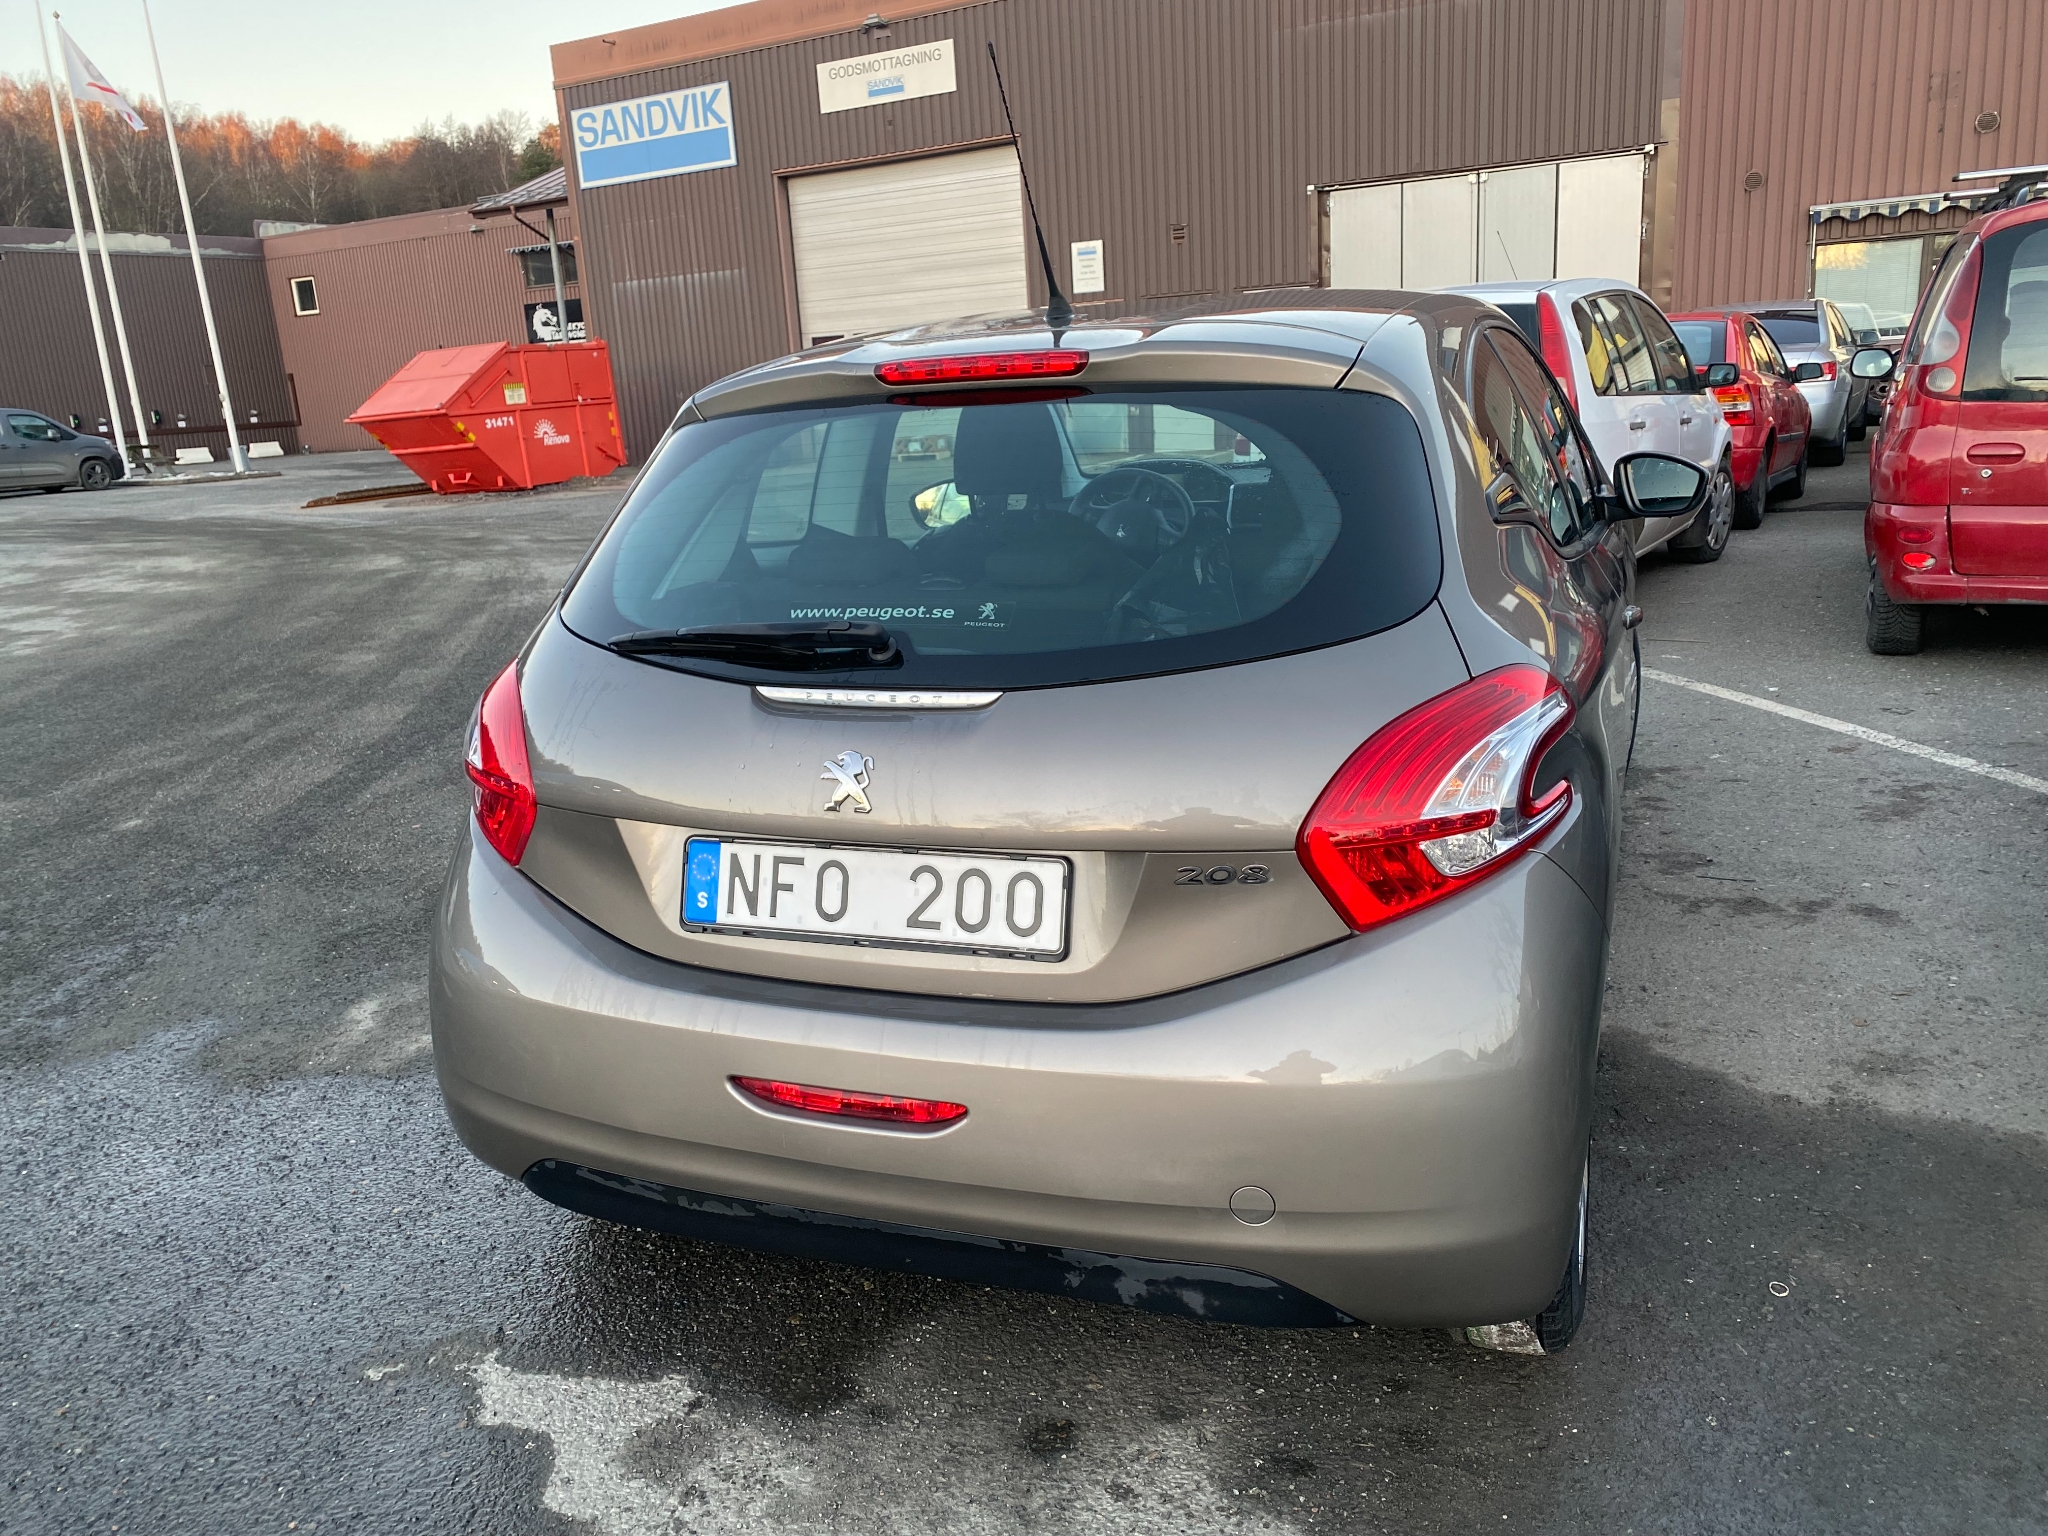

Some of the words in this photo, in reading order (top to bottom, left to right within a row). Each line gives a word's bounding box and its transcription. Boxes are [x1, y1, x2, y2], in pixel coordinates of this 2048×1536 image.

[828, 48, 942, 80] GODSMOTTAGNING
[867, 76, 904, 90] SANDVIK
[576, 87, 727, 148] SANDVIK
[484, 416, 514, 429] 31471
[543, 434, 570, 446] Renova
[790, 605, 955, 621] www.peugeot.se
[805, 691, 943, 704] PEUGEOT
[1174, 864, 1270, 886] 208
[696, 892, 709, 909] S
[726, 853, 850, 923] NFO
[906, 864, 1045, 938] 200
